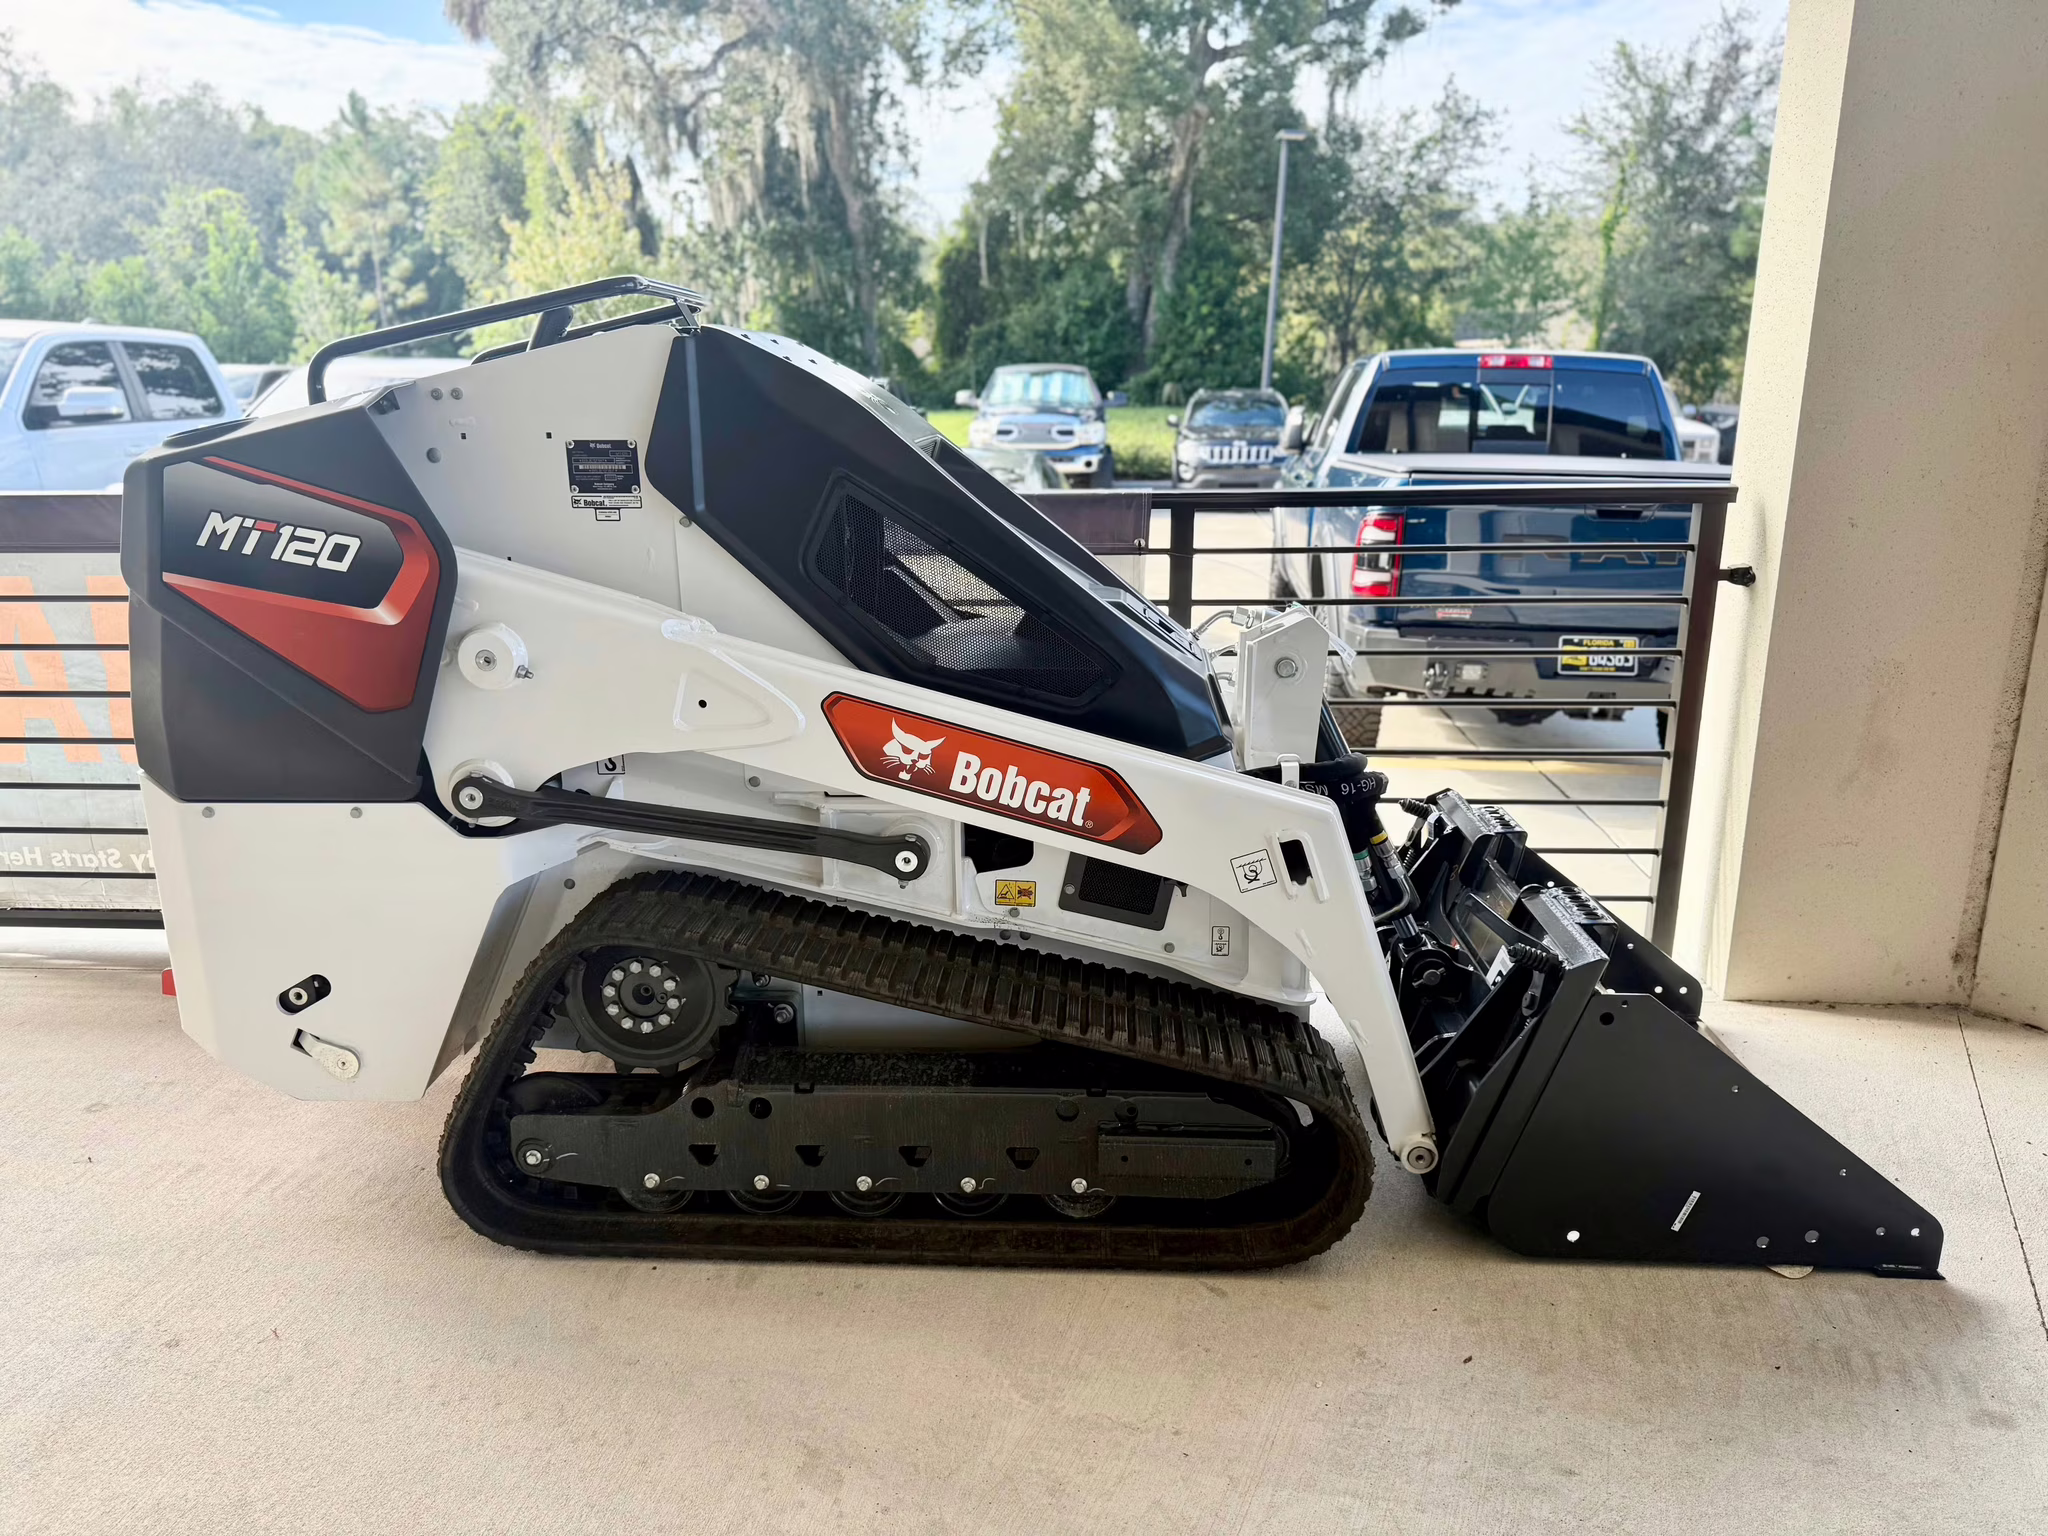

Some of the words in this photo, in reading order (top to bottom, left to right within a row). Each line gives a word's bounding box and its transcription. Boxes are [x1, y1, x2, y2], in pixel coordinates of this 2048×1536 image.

[583, 499, 607, 507] Bobcat
[196, 511, 362, 573] MT120
[1583, 639, 1615, 647] FLORIDA
[1341, 777, 1376, 795] HG-16
